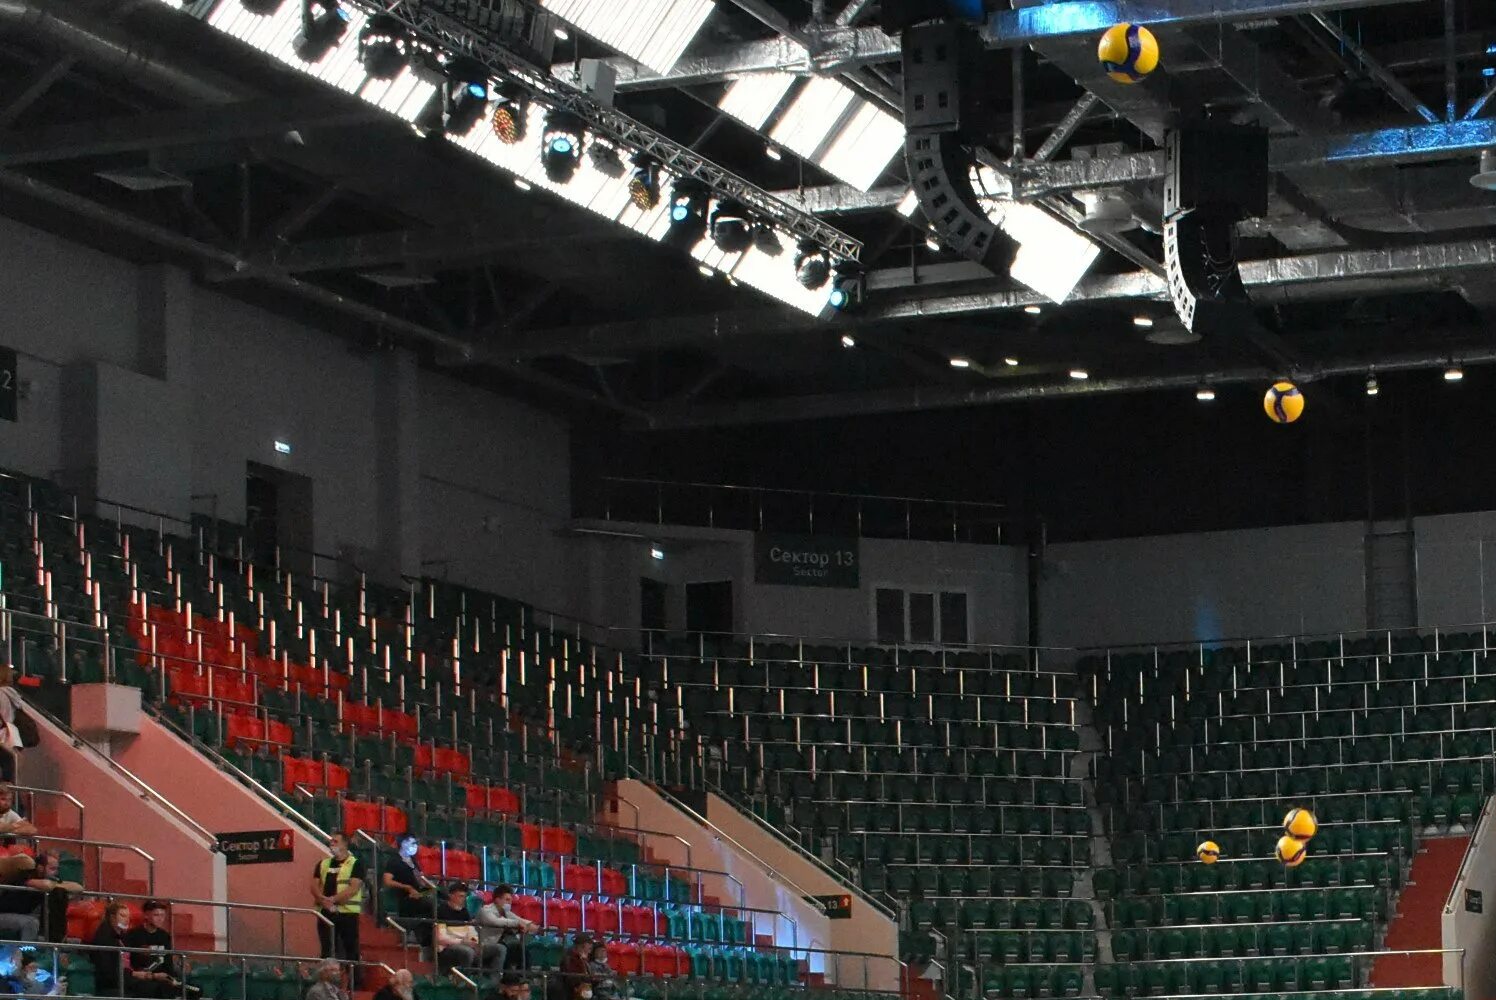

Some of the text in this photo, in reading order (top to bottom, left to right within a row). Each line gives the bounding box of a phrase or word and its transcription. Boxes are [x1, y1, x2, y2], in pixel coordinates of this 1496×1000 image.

[770, 547, 854, 568] Сектор 13
[793, 564, 829, 577] Sector
[221, 838, 276, 853] Сектор 12
